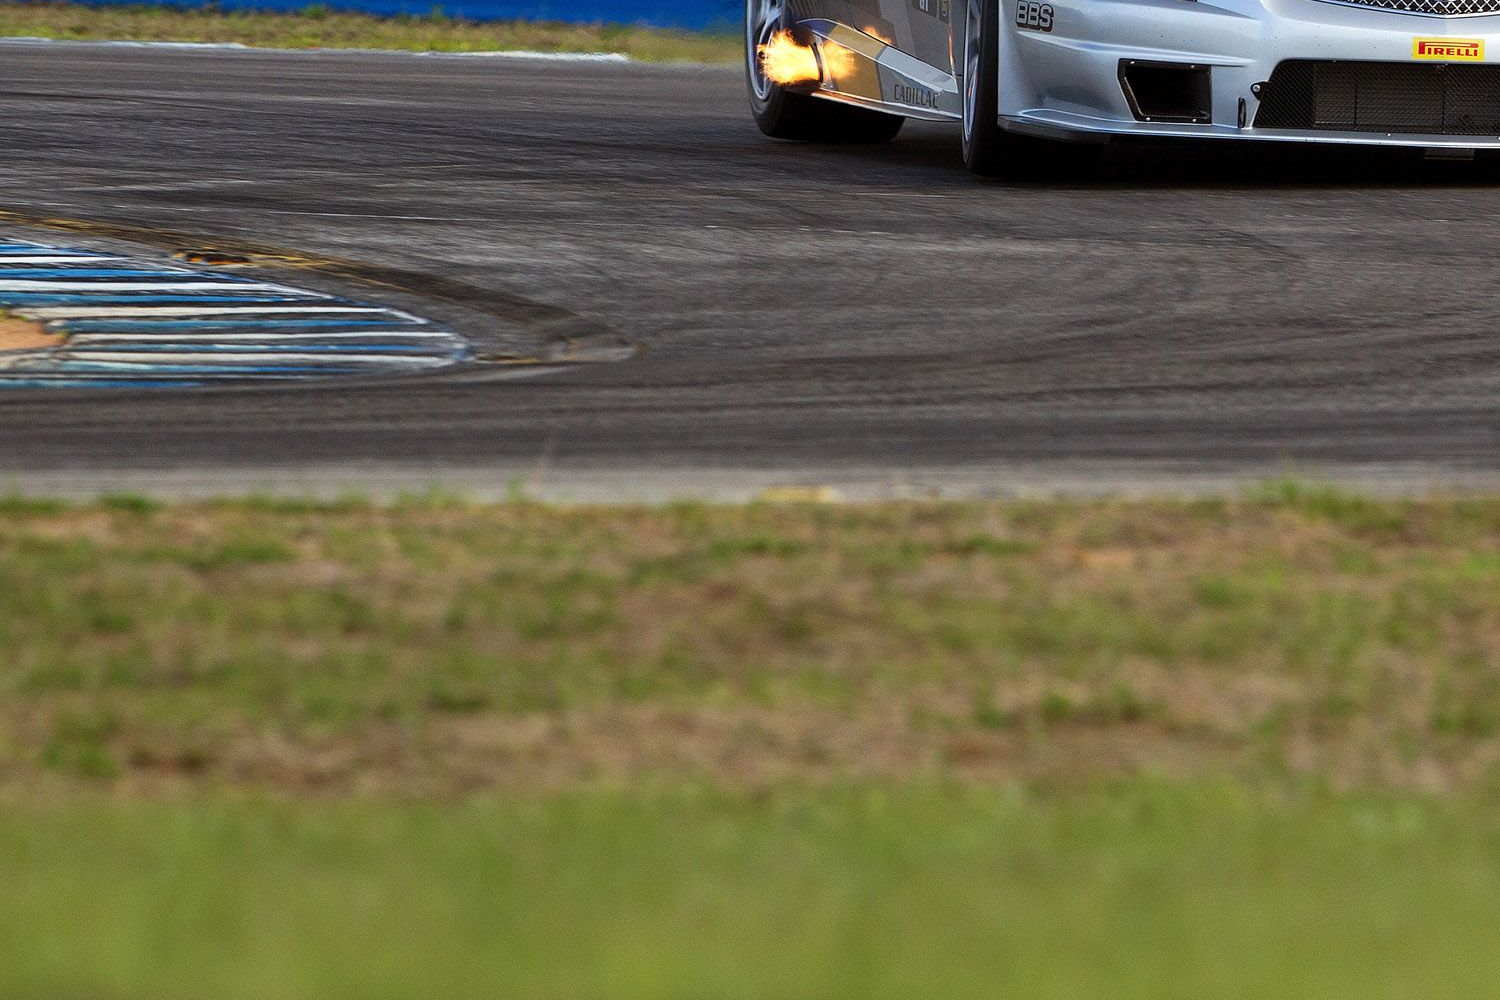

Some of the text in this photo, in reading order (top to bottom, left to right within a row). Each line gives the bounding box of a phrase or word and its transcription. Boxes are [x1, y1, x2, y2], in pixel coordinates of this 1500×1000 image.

[1016, 0, 1054, 32] BBS
[1418, 41, 1479, 56] PIRELLI
[894, 84, 939, 108] CADILLAC
